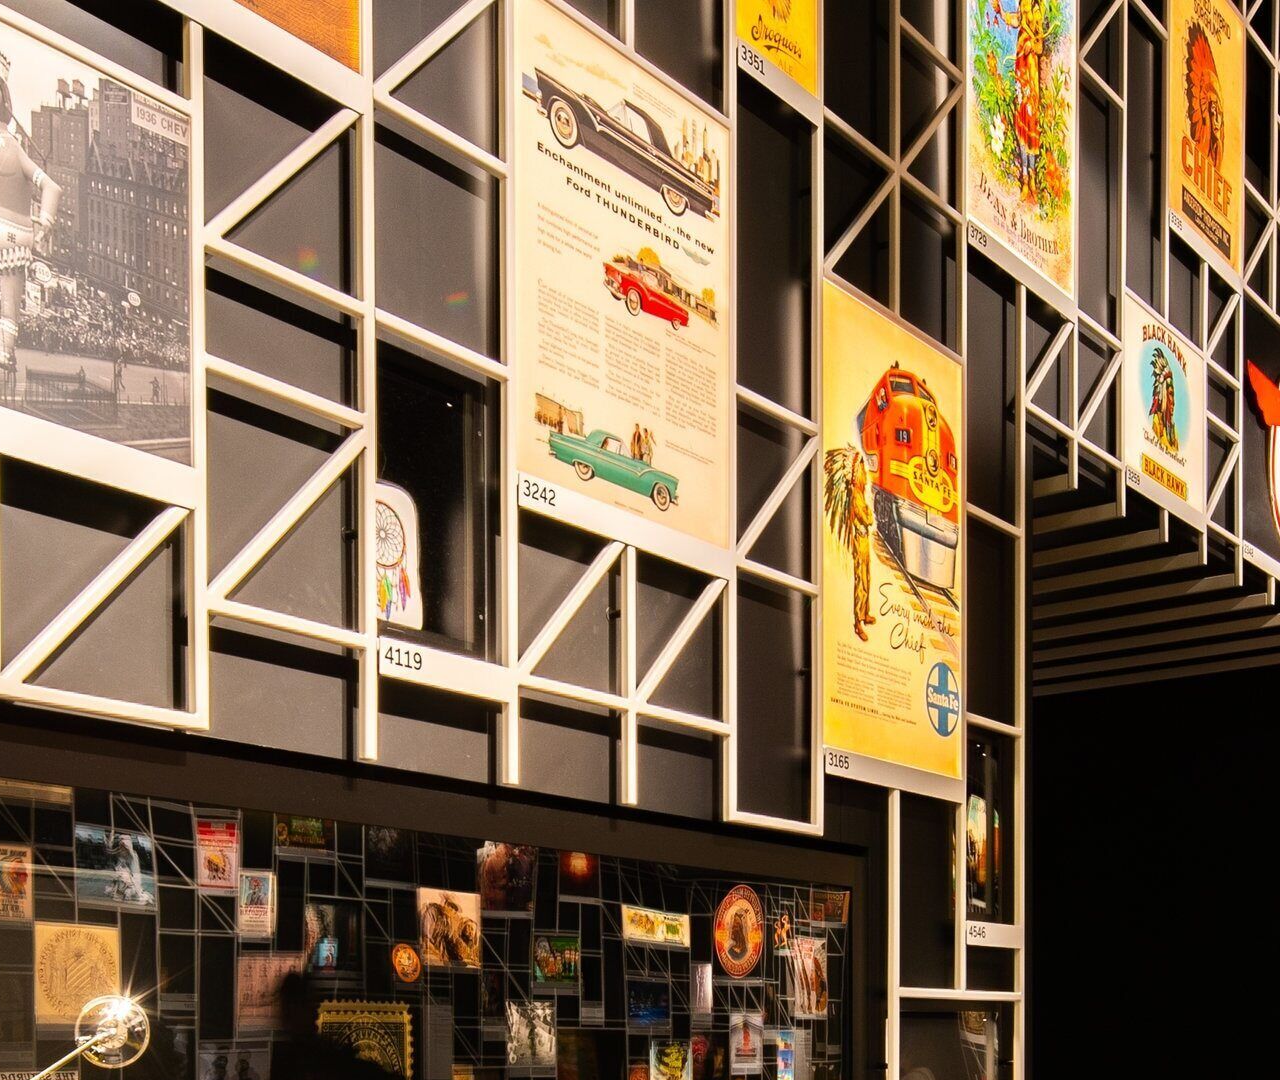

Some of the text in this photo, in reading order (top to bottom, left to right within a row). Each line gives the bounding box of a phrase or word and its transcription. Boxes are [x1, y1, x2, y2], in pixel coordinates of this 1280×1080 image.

[751, 13, 802, 60] Iroquois
[741, 45, 766, 76] 3351
[136, 106, 157, 127] 1936
[1182, 135, 1232, 217] CHIEF
[537, 141, 611, 193] Enchantment
[695, 238, 715, 256] new
[566, 176, 591, 198] Ford
[595, 193, 680, 250] THUNDERBIRD
[970, 225, 988, 248] 3729
[1142, 324, 1187, 379] BLACK HAWK
[898, 429, 908, 443] 19
[913, 470, 952, 499] SANTA FE
[1144, 457, 1185, 498] BLACK HAWK
[523, 479, 556, 507] 3242
[878, 582, 910, 623] Every
[937, 612, 956, 638] the
[384, 646, 423, 671] 4119
[889, 622, 927, 665] Chief
[927, 686, 950, 709] Santa
[949, 692, 960, 713] Fe
[828, 752, 850, 770] 3165
[969, 925, 987, 941] 4546
